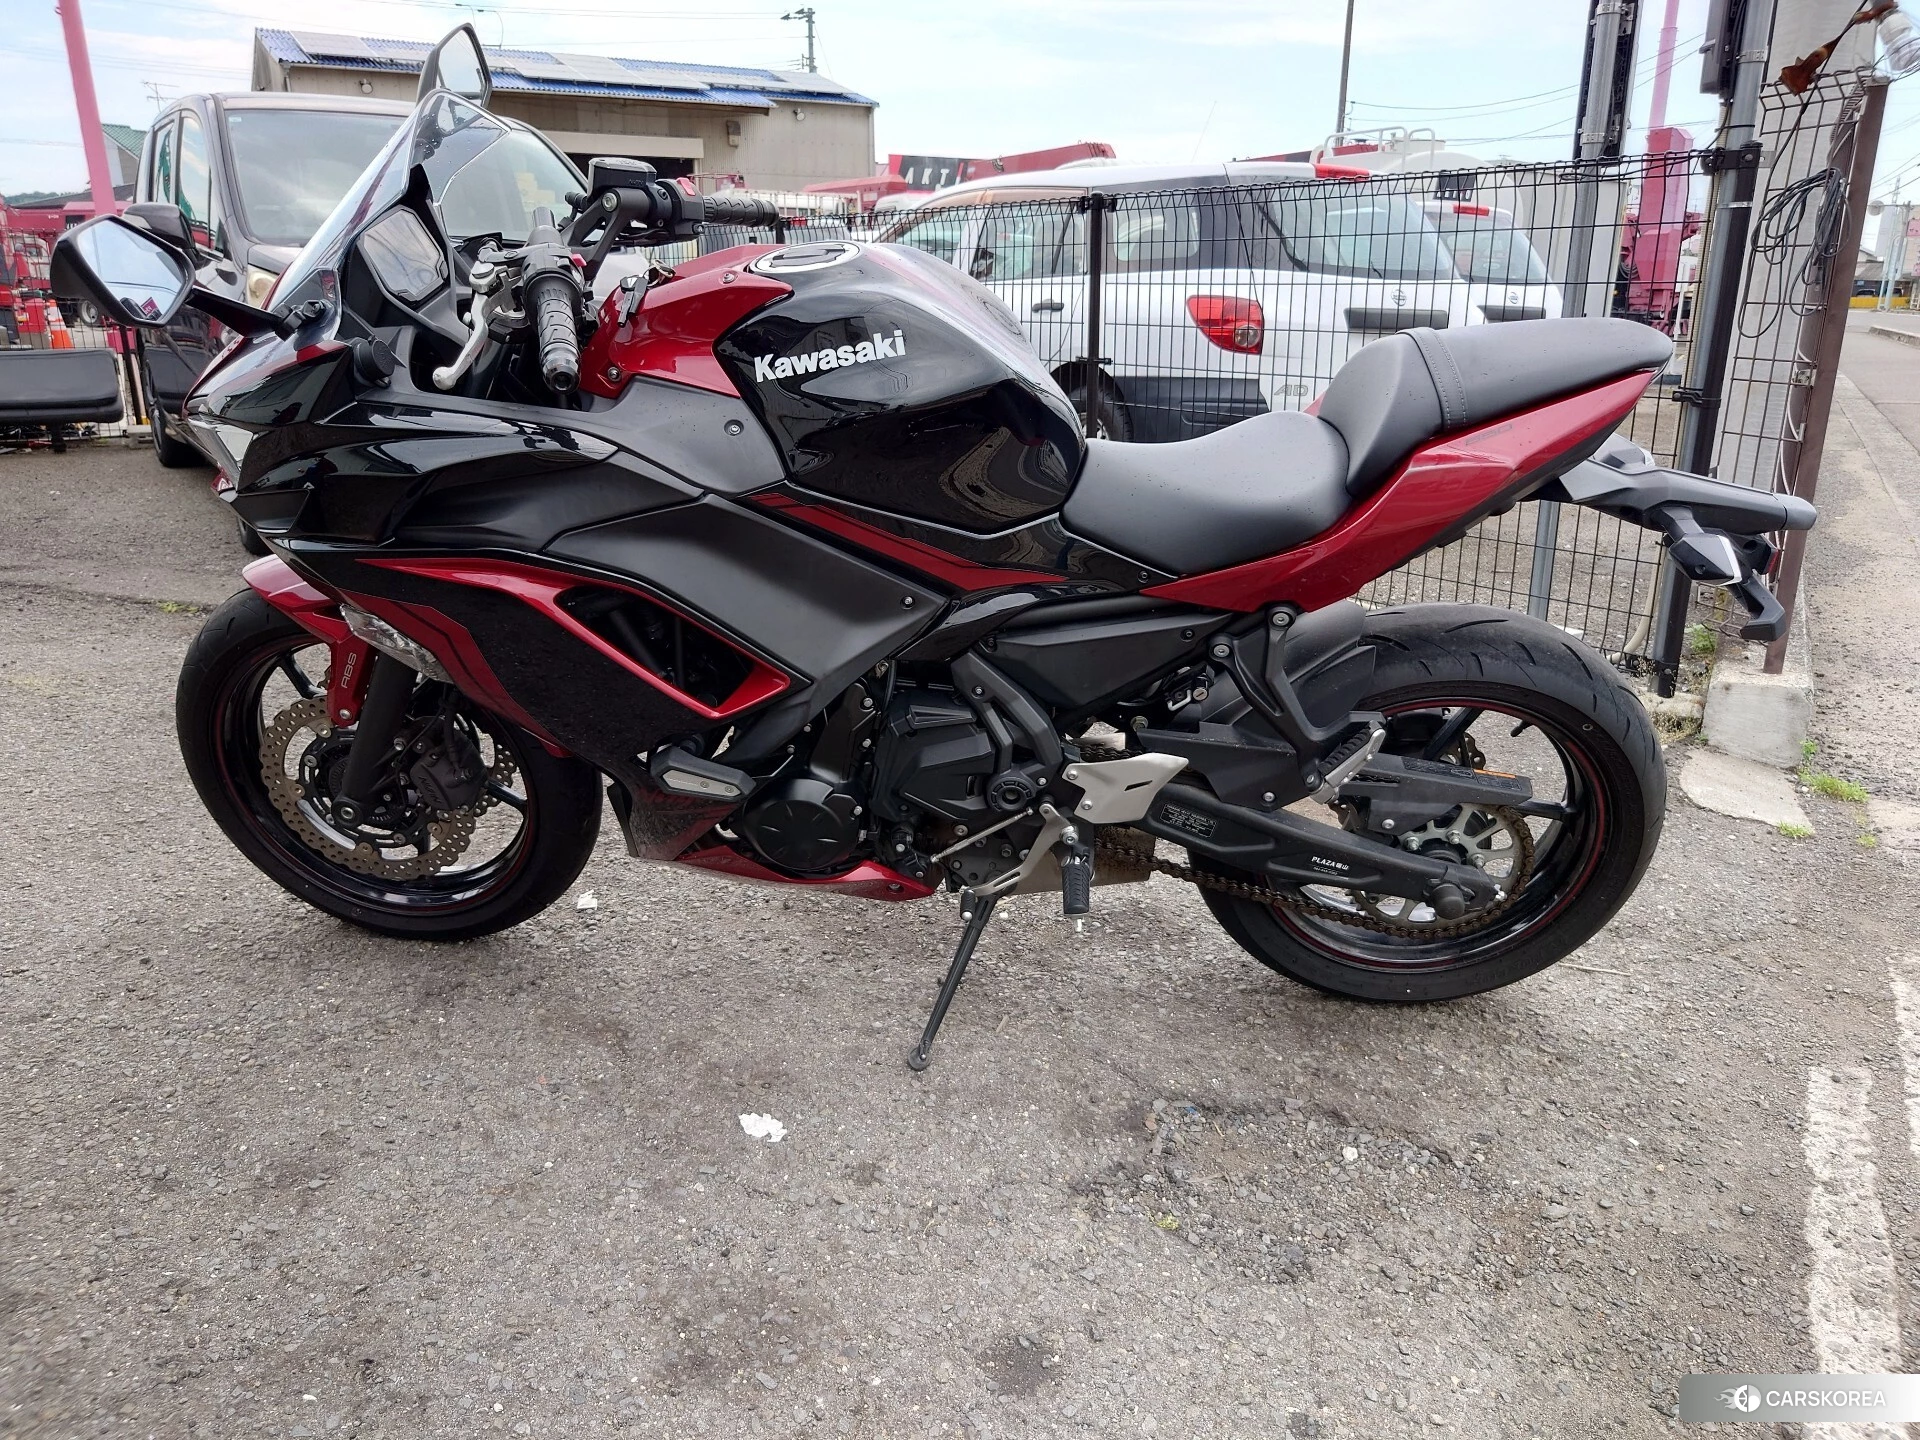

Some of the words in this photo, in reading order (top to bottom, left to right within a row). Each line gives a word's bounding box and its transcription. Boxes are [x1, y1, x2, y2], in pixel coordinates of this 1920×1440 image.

[754, 329, 906, 383] Kawasaki
[1274, 384, 1309, 397] AD
[341, 652, 357, 689] ABS
